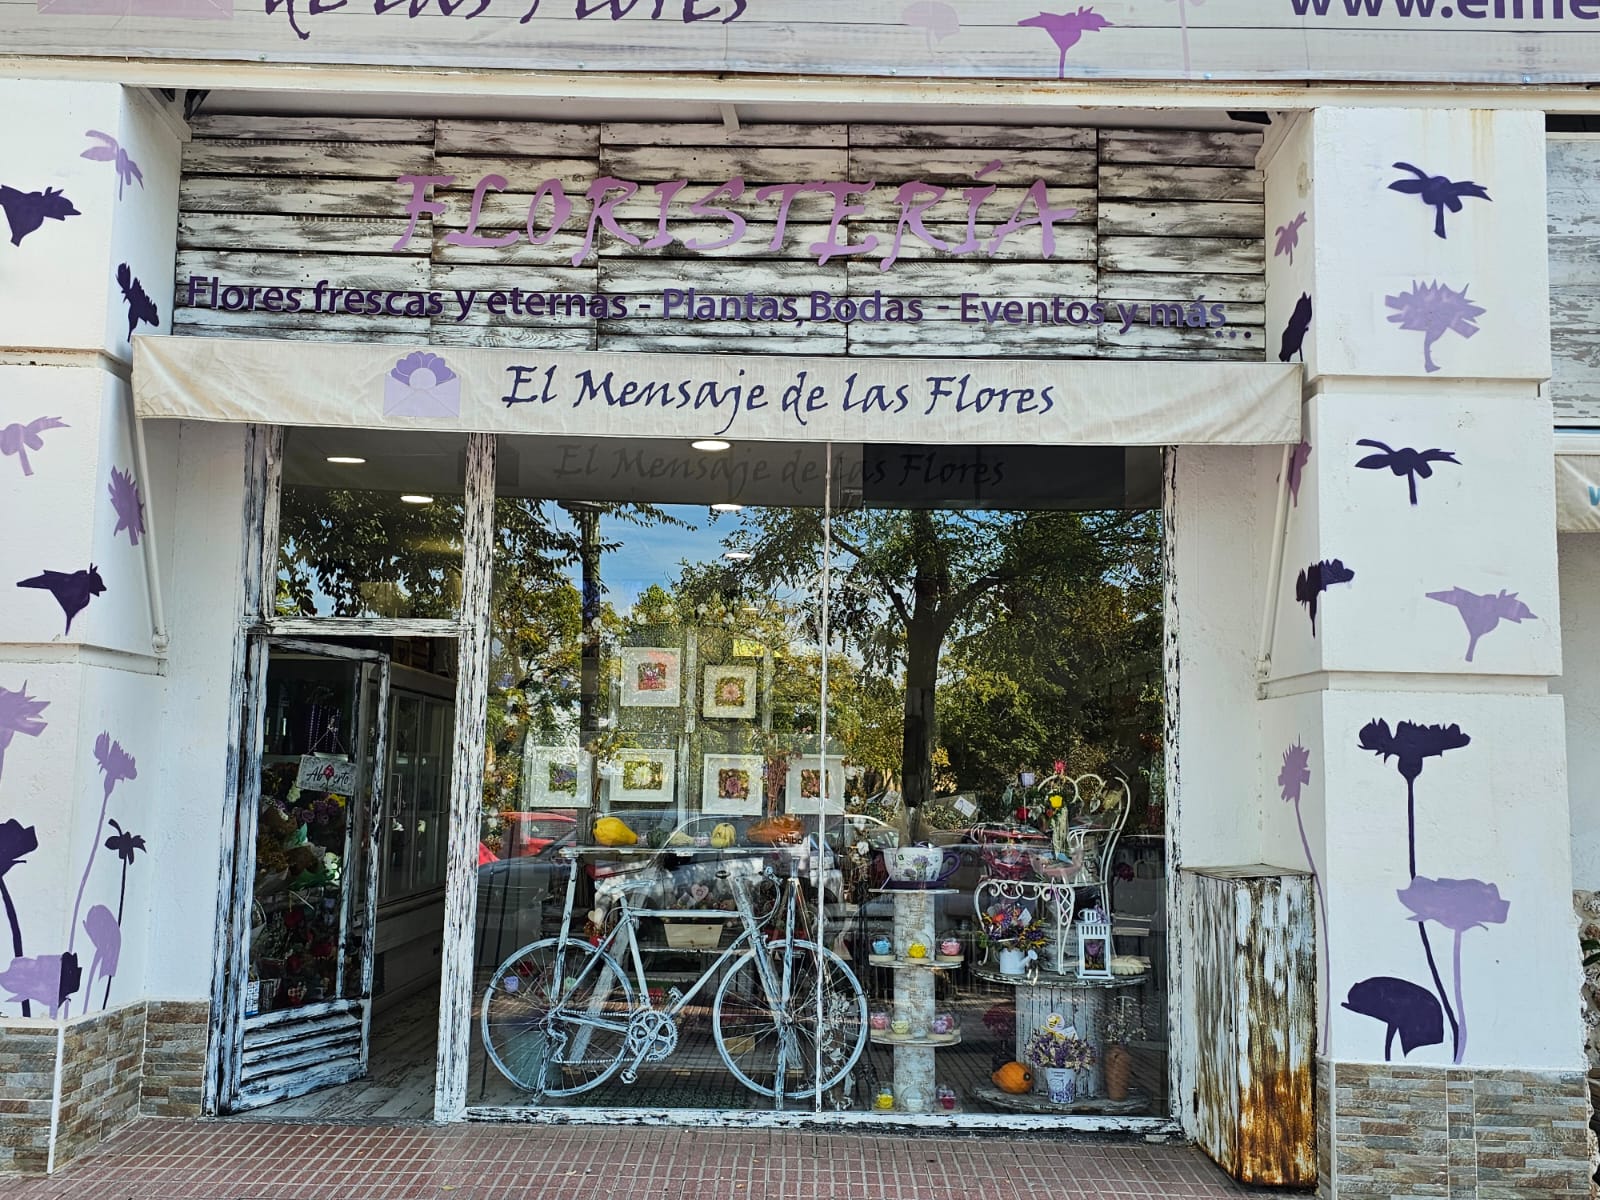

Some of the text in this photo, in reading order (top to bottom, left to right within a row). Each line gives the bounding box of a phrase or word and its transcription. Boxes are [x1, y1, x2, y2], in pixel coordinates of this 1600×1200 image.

[393, 160, 1077, 271] FLORISTERÍA
[187, 275, 301, 313] Flores
[313, 280, 444, 317] frescas
[454, 291, 477, 321] y
[487, 289, 628, 320] eternas
[961, 292, 1107, 326] Eventos
[1117, 303, 1139, 335] y
[501, 365, 1055, 435] El Mensaje de las Flores
[306, 764, 350, 788] Aberto
